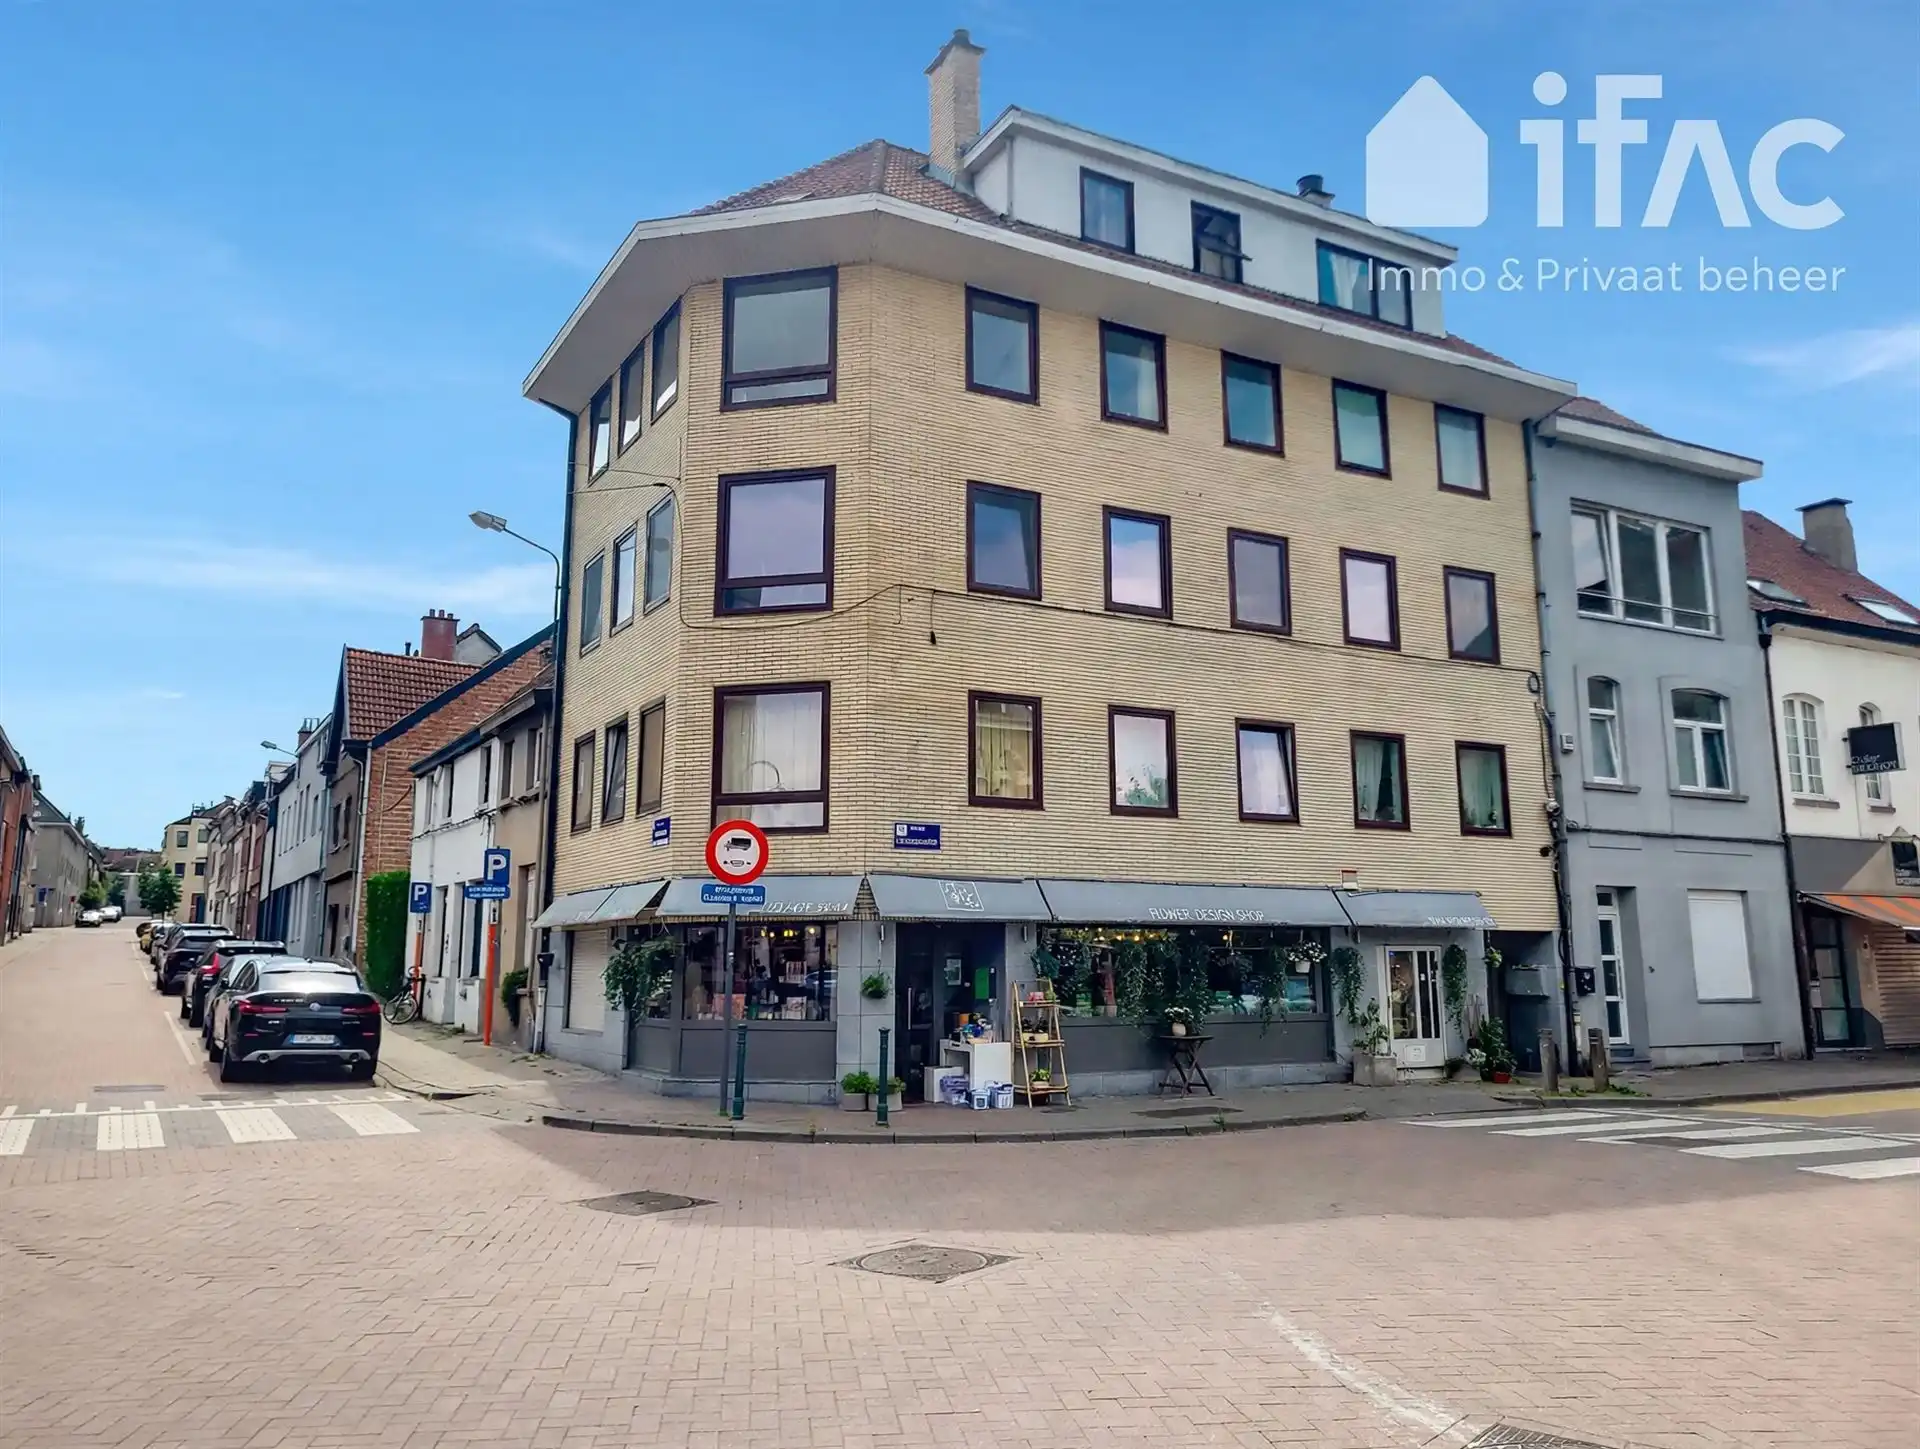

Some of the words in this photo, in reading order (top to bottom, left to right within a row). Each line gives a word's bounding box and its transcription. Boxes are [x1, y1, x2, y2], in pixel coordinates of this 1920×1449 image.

[487, 854, 507, 880] P
[414, 884, 427, 901] P
[1148, 907, 1190, 920] FLOWER
[1194, 908, 1236, 921] DESIGN
[1236, 909, 1265, 921] SHOP
